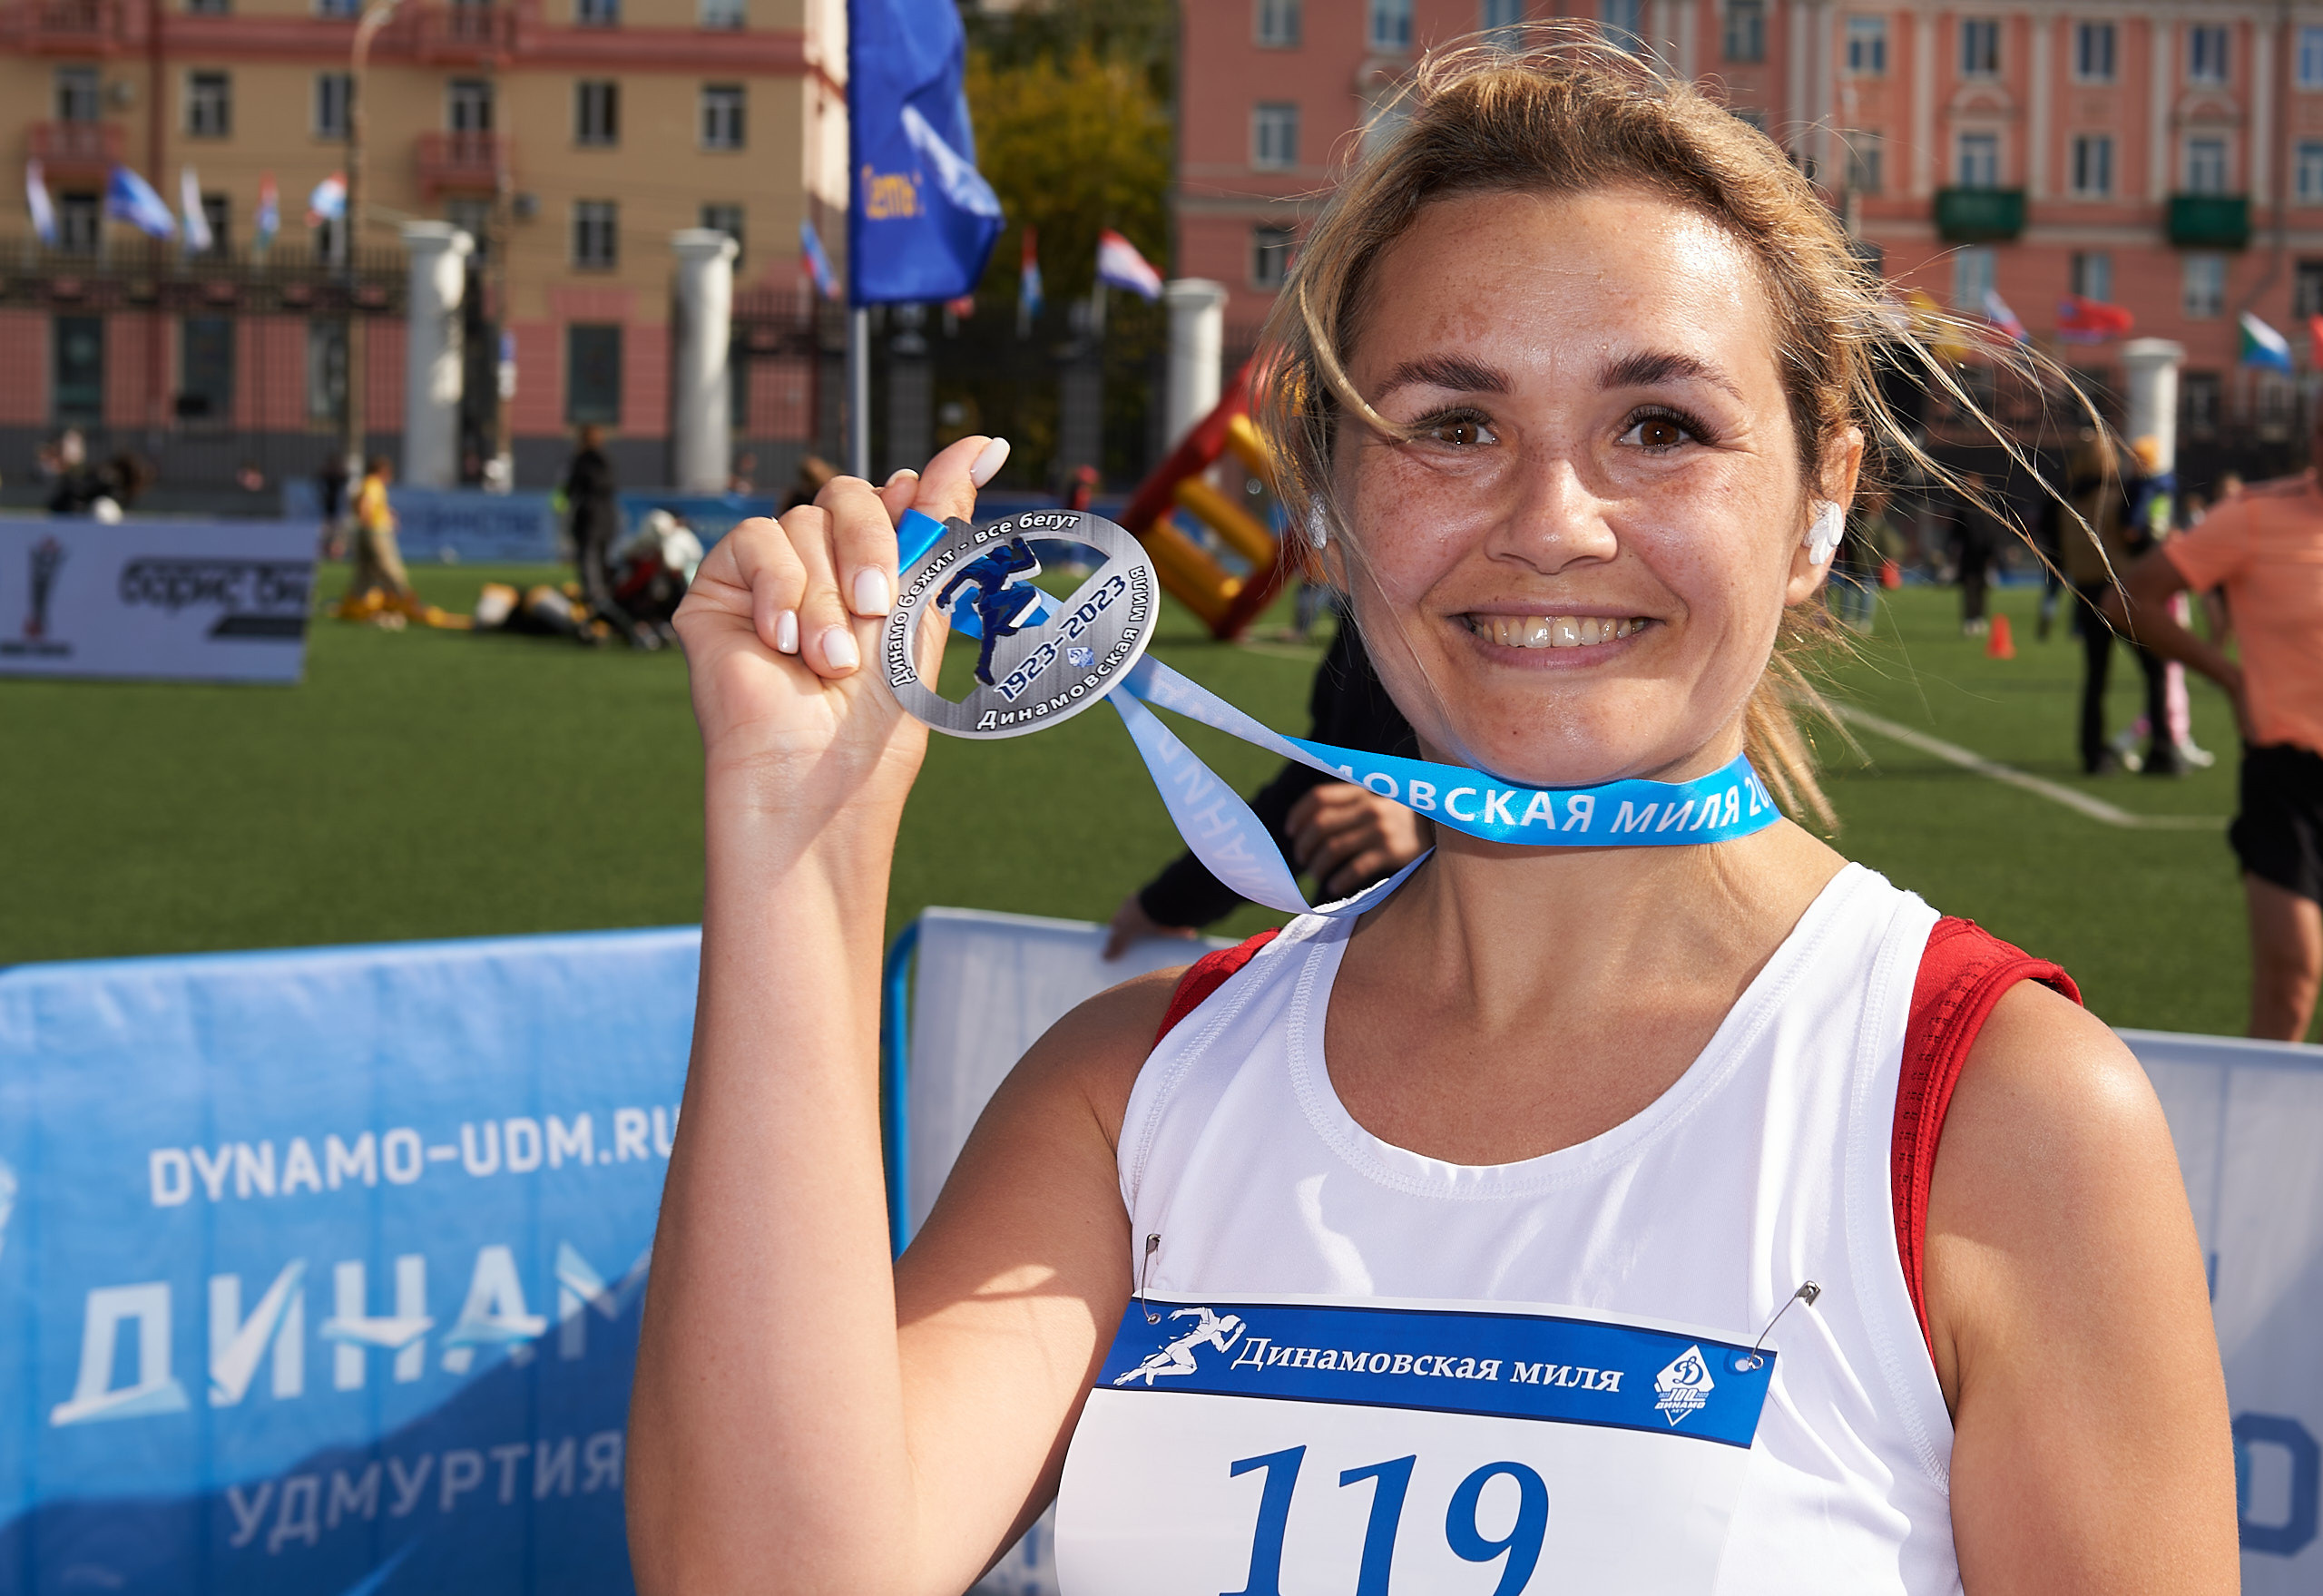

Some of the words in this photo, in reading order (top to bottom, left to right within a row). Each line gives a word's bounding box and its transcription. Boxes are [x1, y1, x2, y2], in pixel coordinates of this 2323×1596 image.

[974, 522, 1012, 544] все
[1019, 513, 1081, 530] бегут
[899, 550, 956, 608] бежит
[887, 611, 917, 687] Динамо
[976, 627, 1139, 730] Динамовская
[1129, 565, 1150, 622] миля
[995, 574, 1127, 702] 1923-2023
[1610, 785, 1740, 834] МИЛЯ
[1744, 772, 1774, 817] 20
[149, 1105, 680, 1207] DYNAMO-UDM.RU
[1231, 1337, 1503, 1380] Динамовская
[1510, 1361, 1624, 1392] миля
[227, 1430, 624, 1555] УДМУРТИЯ
[1220, 1444, 1549, 1596] 119
